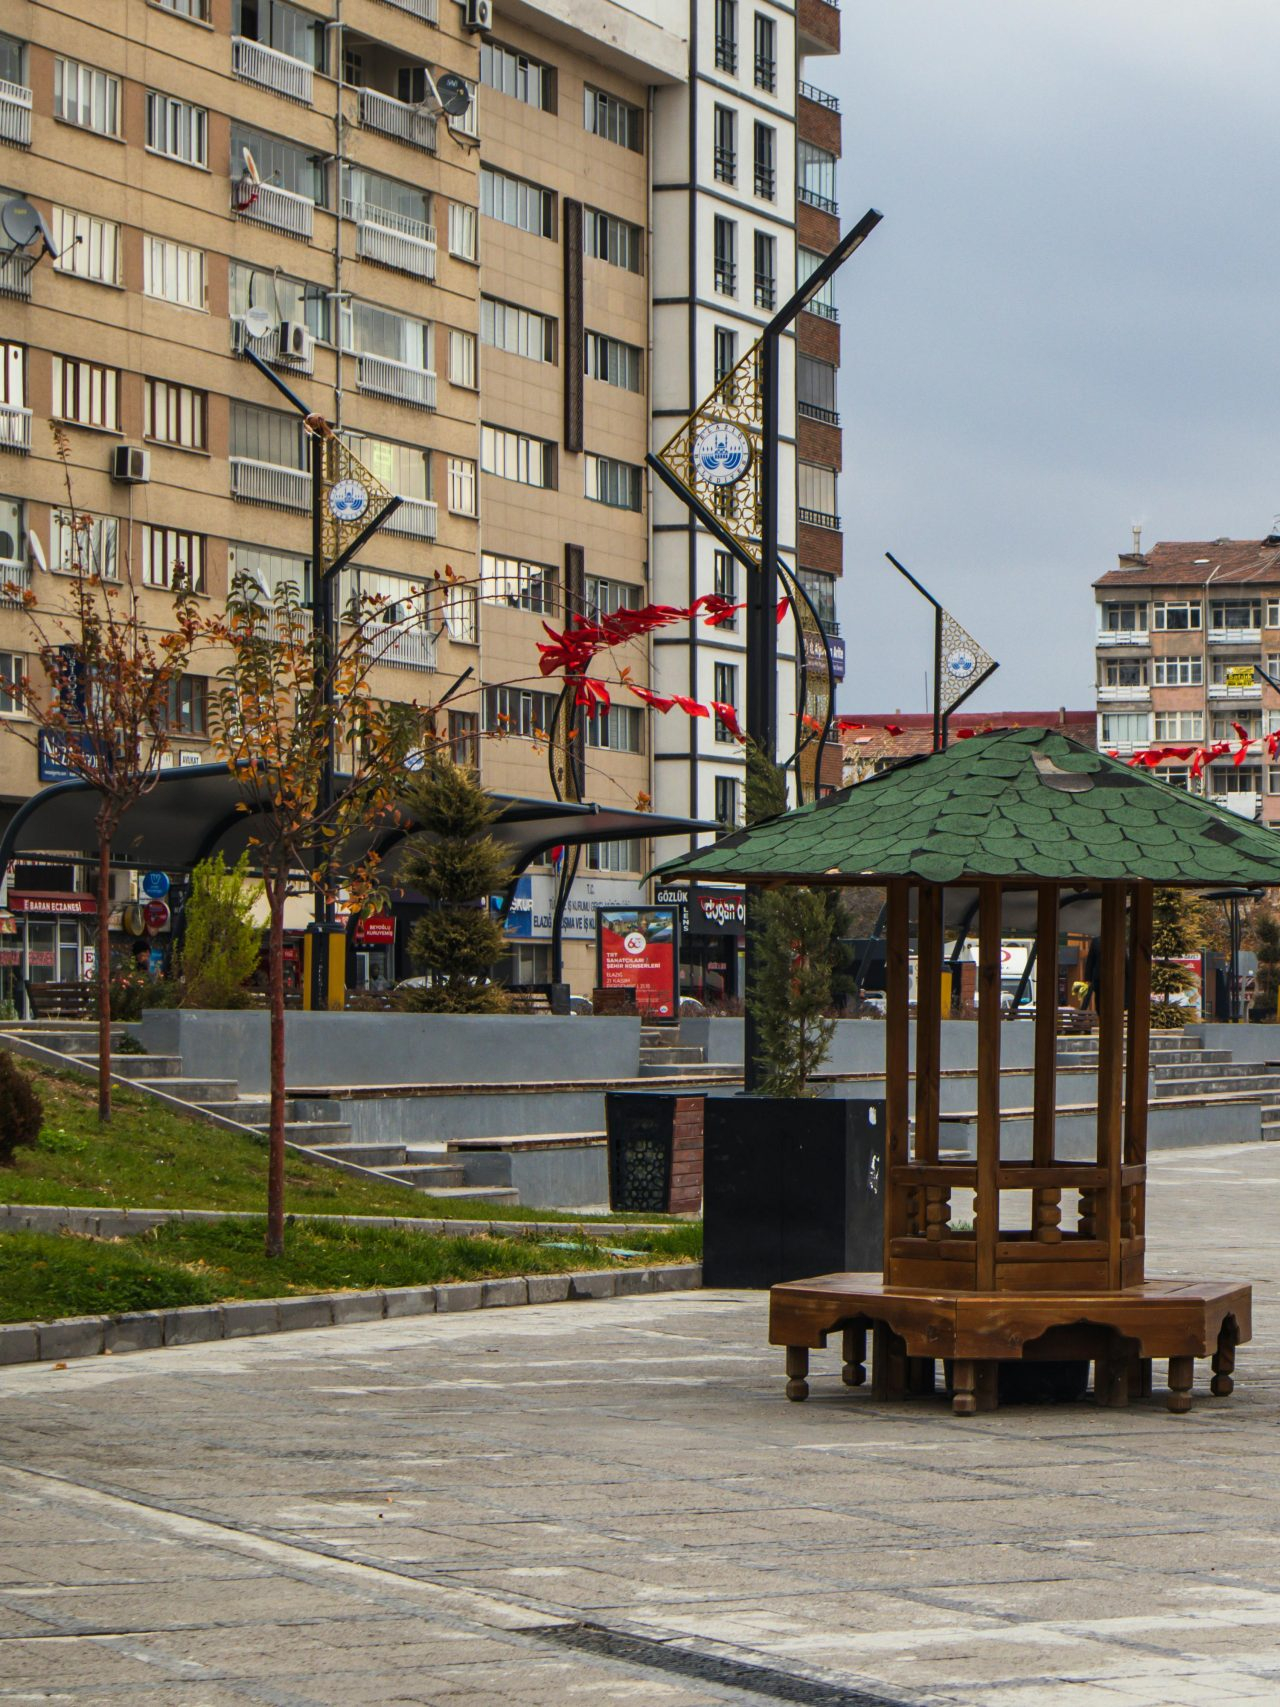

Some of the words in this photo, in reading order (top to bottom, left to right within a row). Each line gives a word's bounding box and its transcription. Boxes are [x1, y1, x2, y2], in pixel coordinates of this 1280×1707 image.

[657, 890, 688, 903] GÖZLÜK
[29, 901, 51, 911] BARAN
[51, 901, 82, 912] ECZANESİ
